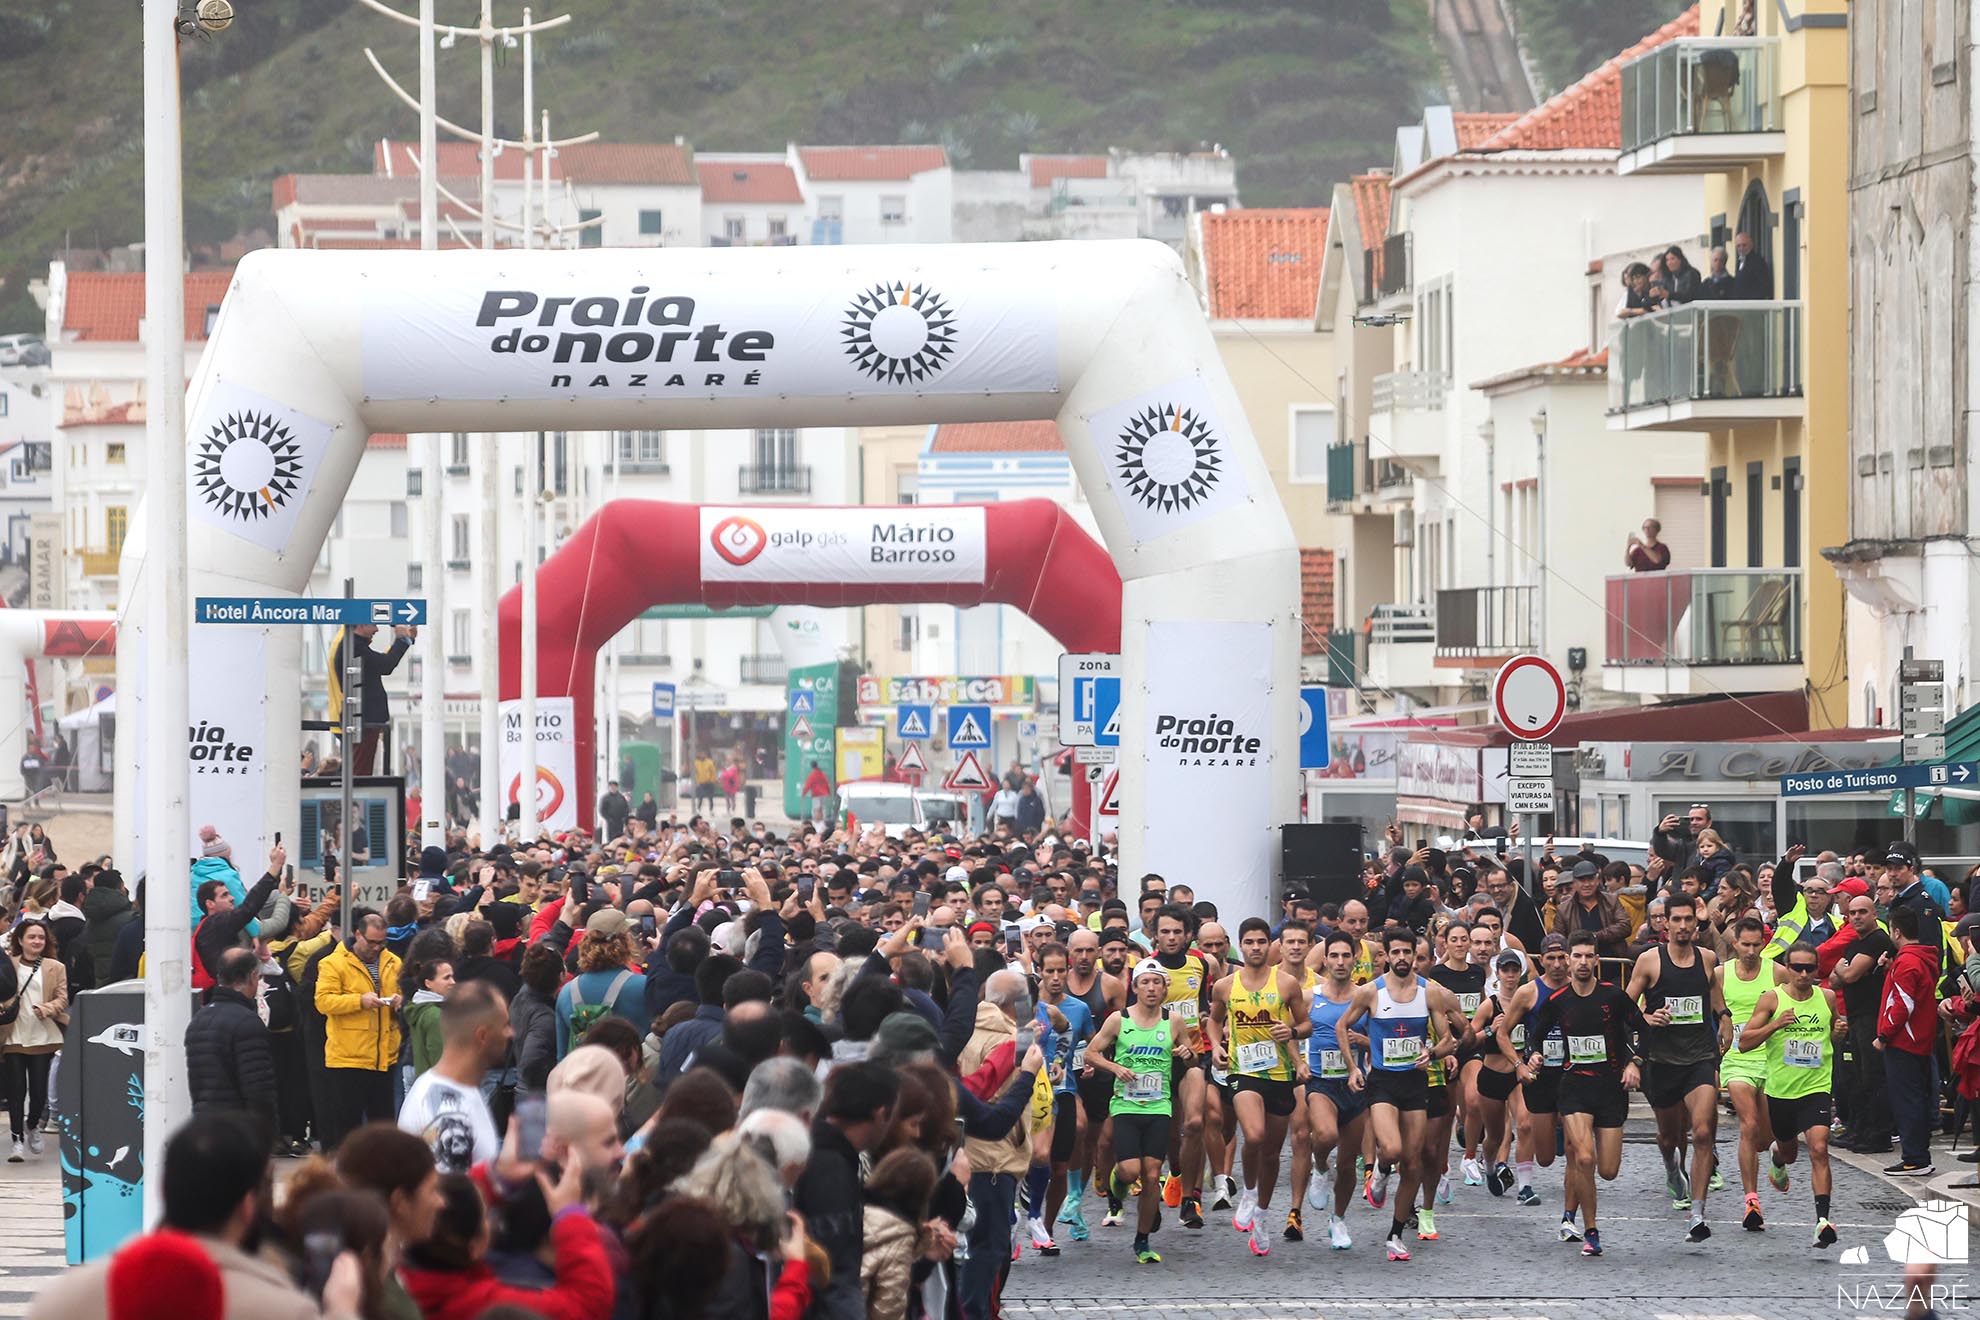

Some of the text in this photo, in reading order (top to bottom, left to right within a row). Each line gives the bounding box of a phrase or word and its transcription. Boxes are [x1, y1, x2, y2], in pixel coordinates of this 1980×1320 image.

[475, 286, 696, 327] Praia
[491, 324, 775, 363] do norte
[771, 529, 813, 548] galp
[871, 523, 955, 543] Mário
[870, 546, 956, 563] Barroso
[205, 600, 342, 620] Hotel Âncora Mar
[1079, 661, 1111, 670] zona
[815, 676, 833, 692] CA
[860, 677, 880, 701] a
[887, 677, 1003, 702] fábrica
[506, 712, 562, 729] Mrio
[1155, 713, 1234, 736] Praia
[506, 731, 563, 743] Baoso
[814, 738, 832, 753] CA
[1160, 734, 1261, 754] do norte
[1649, 749, 1701, 778] A
[1787, 773, 1897, 791] Posto de Turismo
[375, 886, 389, 901] 21
